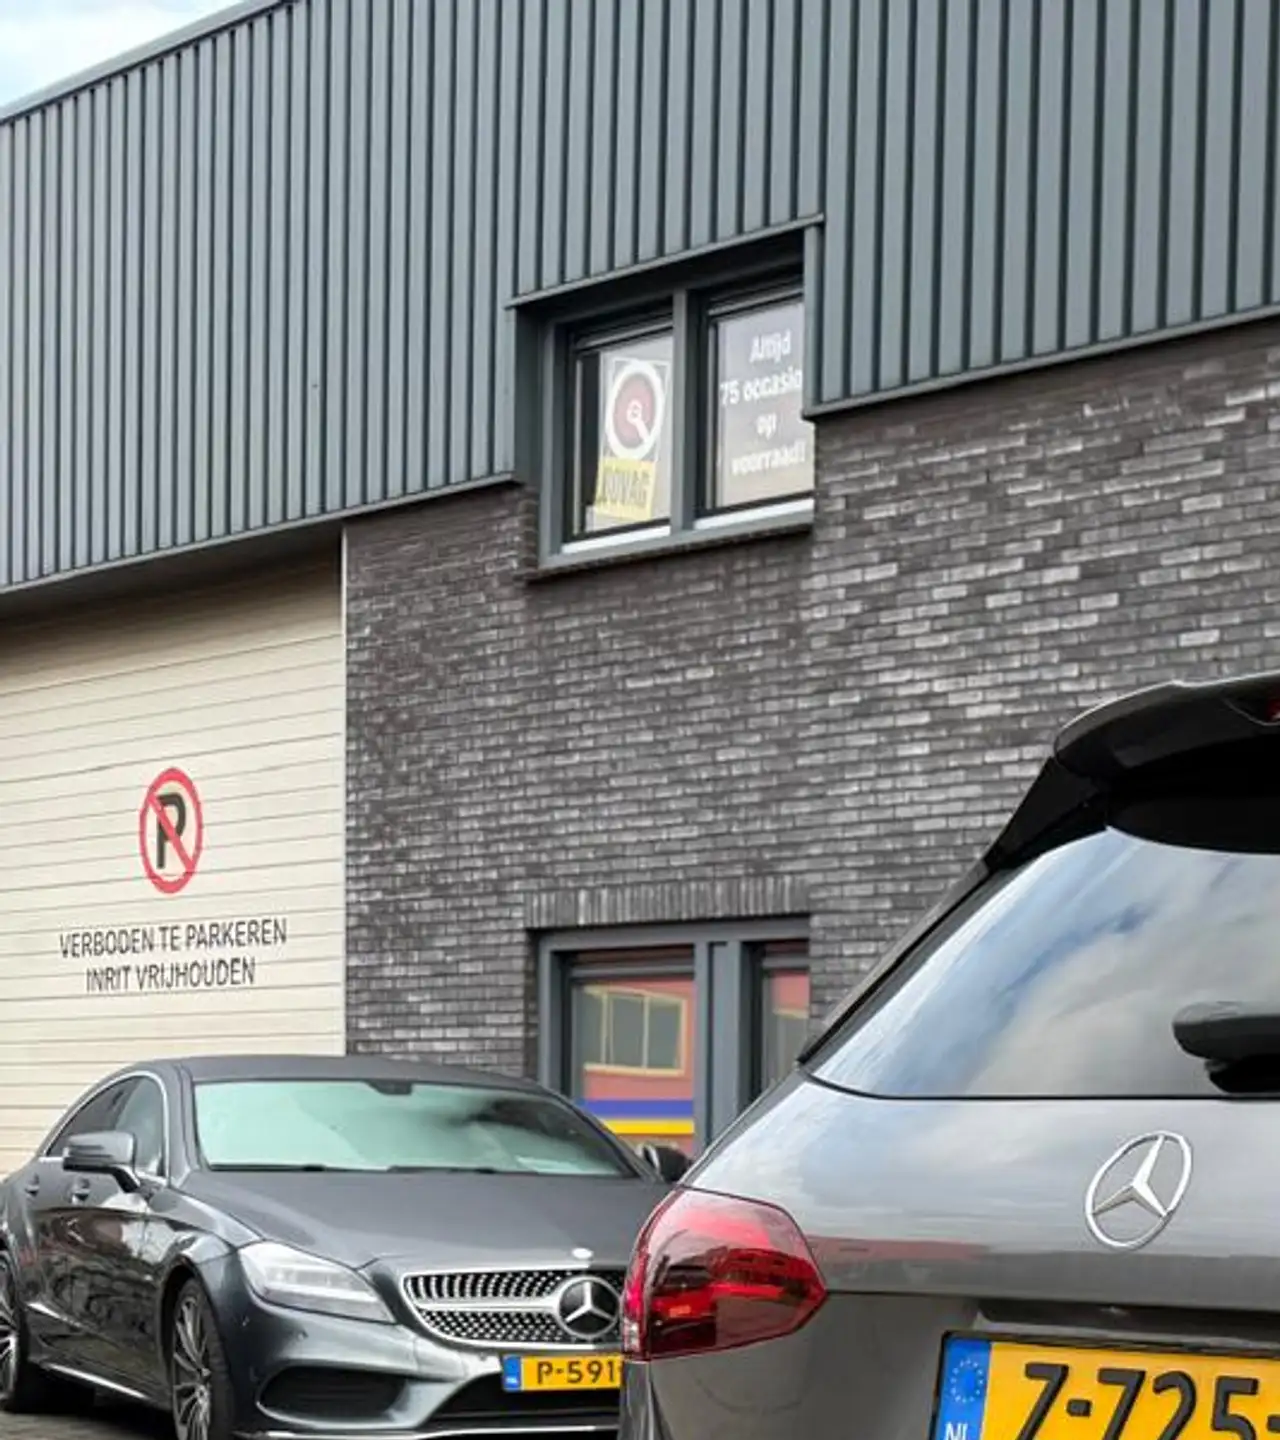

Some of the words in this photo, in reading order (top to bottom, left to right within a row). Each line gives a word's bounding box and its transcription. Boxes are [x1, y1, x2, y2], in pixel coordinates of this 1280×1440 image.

[749, 328, 792, 363] Altijd
[720, 380, 740, 405] 75
[60, 927, 155, 959] VERBODEN
[158, 925, 181, 952] TE
[185, 917, 288, 950] PARKEREN
[86, 965, 131, 992] INRIT
[137, 956, 256, 990] VRIJHOUDEN
[537, 1359, 622, 1385] P-591
